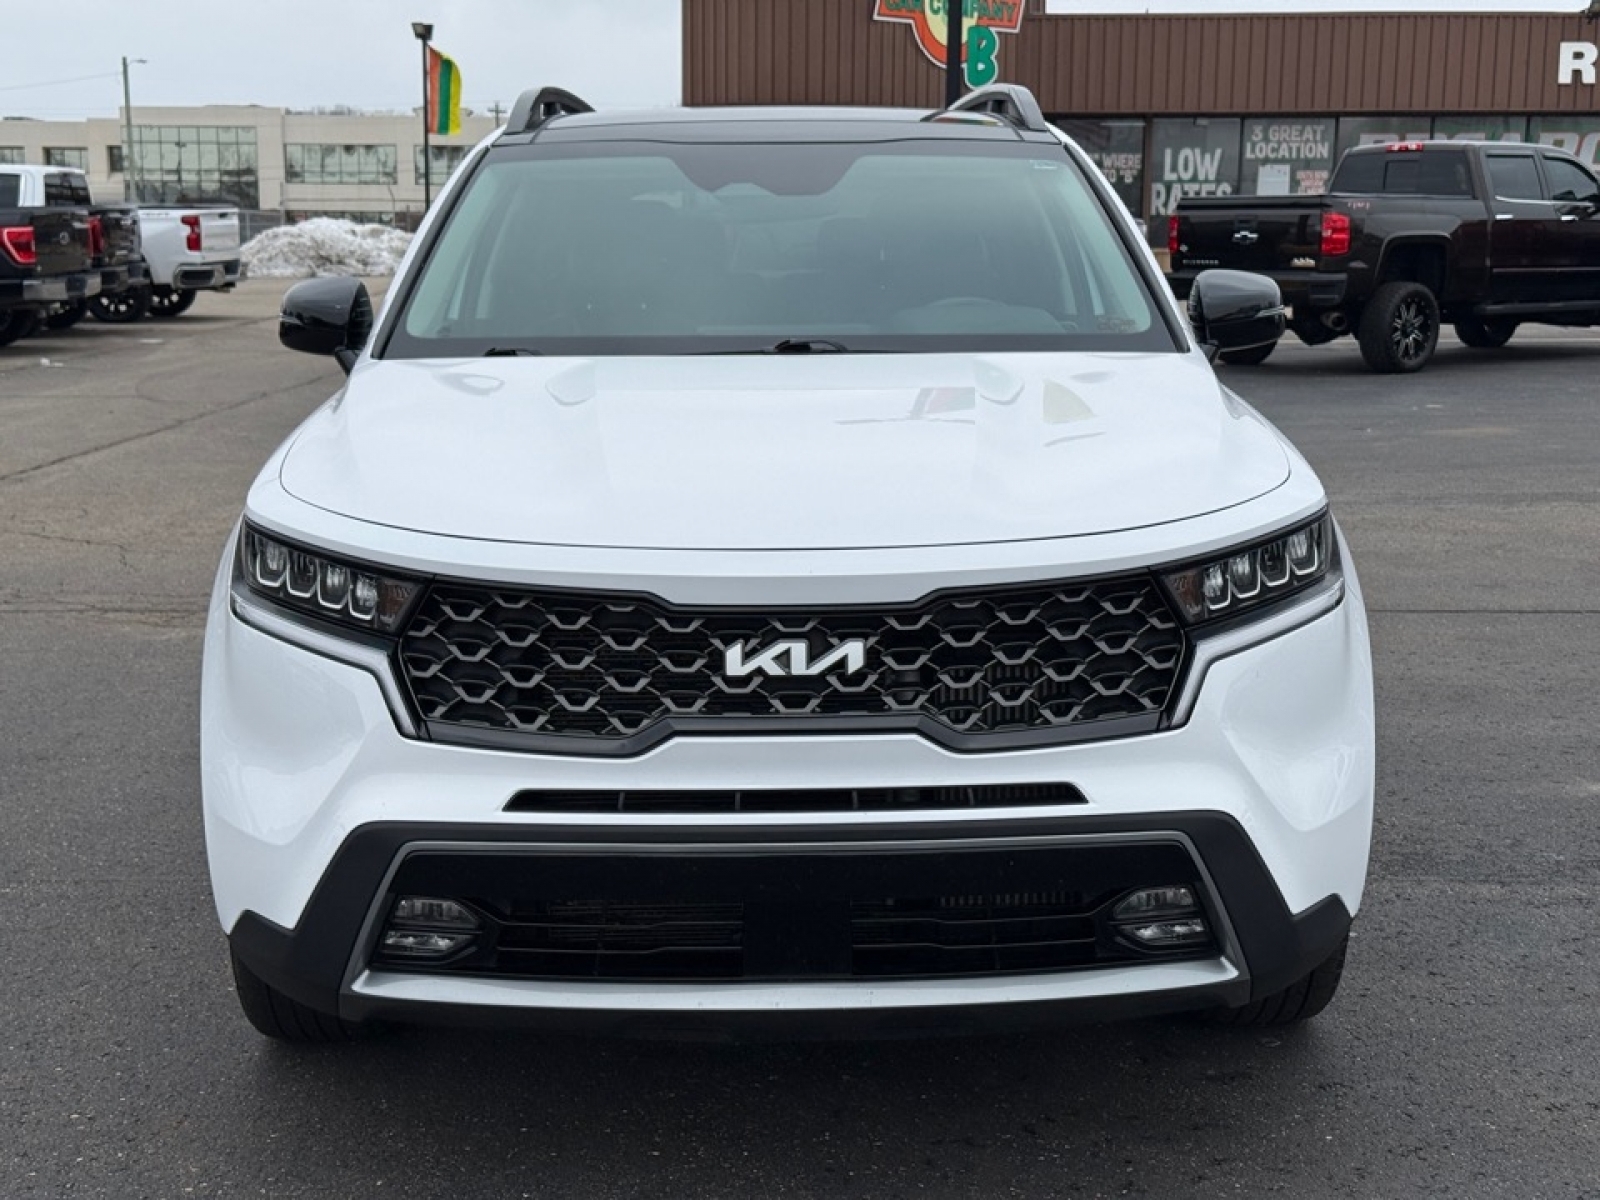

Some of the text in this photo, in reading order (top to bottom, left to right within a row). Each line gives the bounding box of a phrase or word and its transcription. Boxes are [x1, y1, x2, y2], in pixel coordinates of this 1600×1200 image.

[929, 0, 1016, 21] CPANY
[967, 26, 997, 87] B
[1251, 125, 1326, 141] 3 GREAT
[1102, 153, 1142, 169] WHERE
[1245, 142, 1329, 159] LOCATION
[1163, 147, 1222, 181] LOW
[725, 639, 866, 676] KIA
